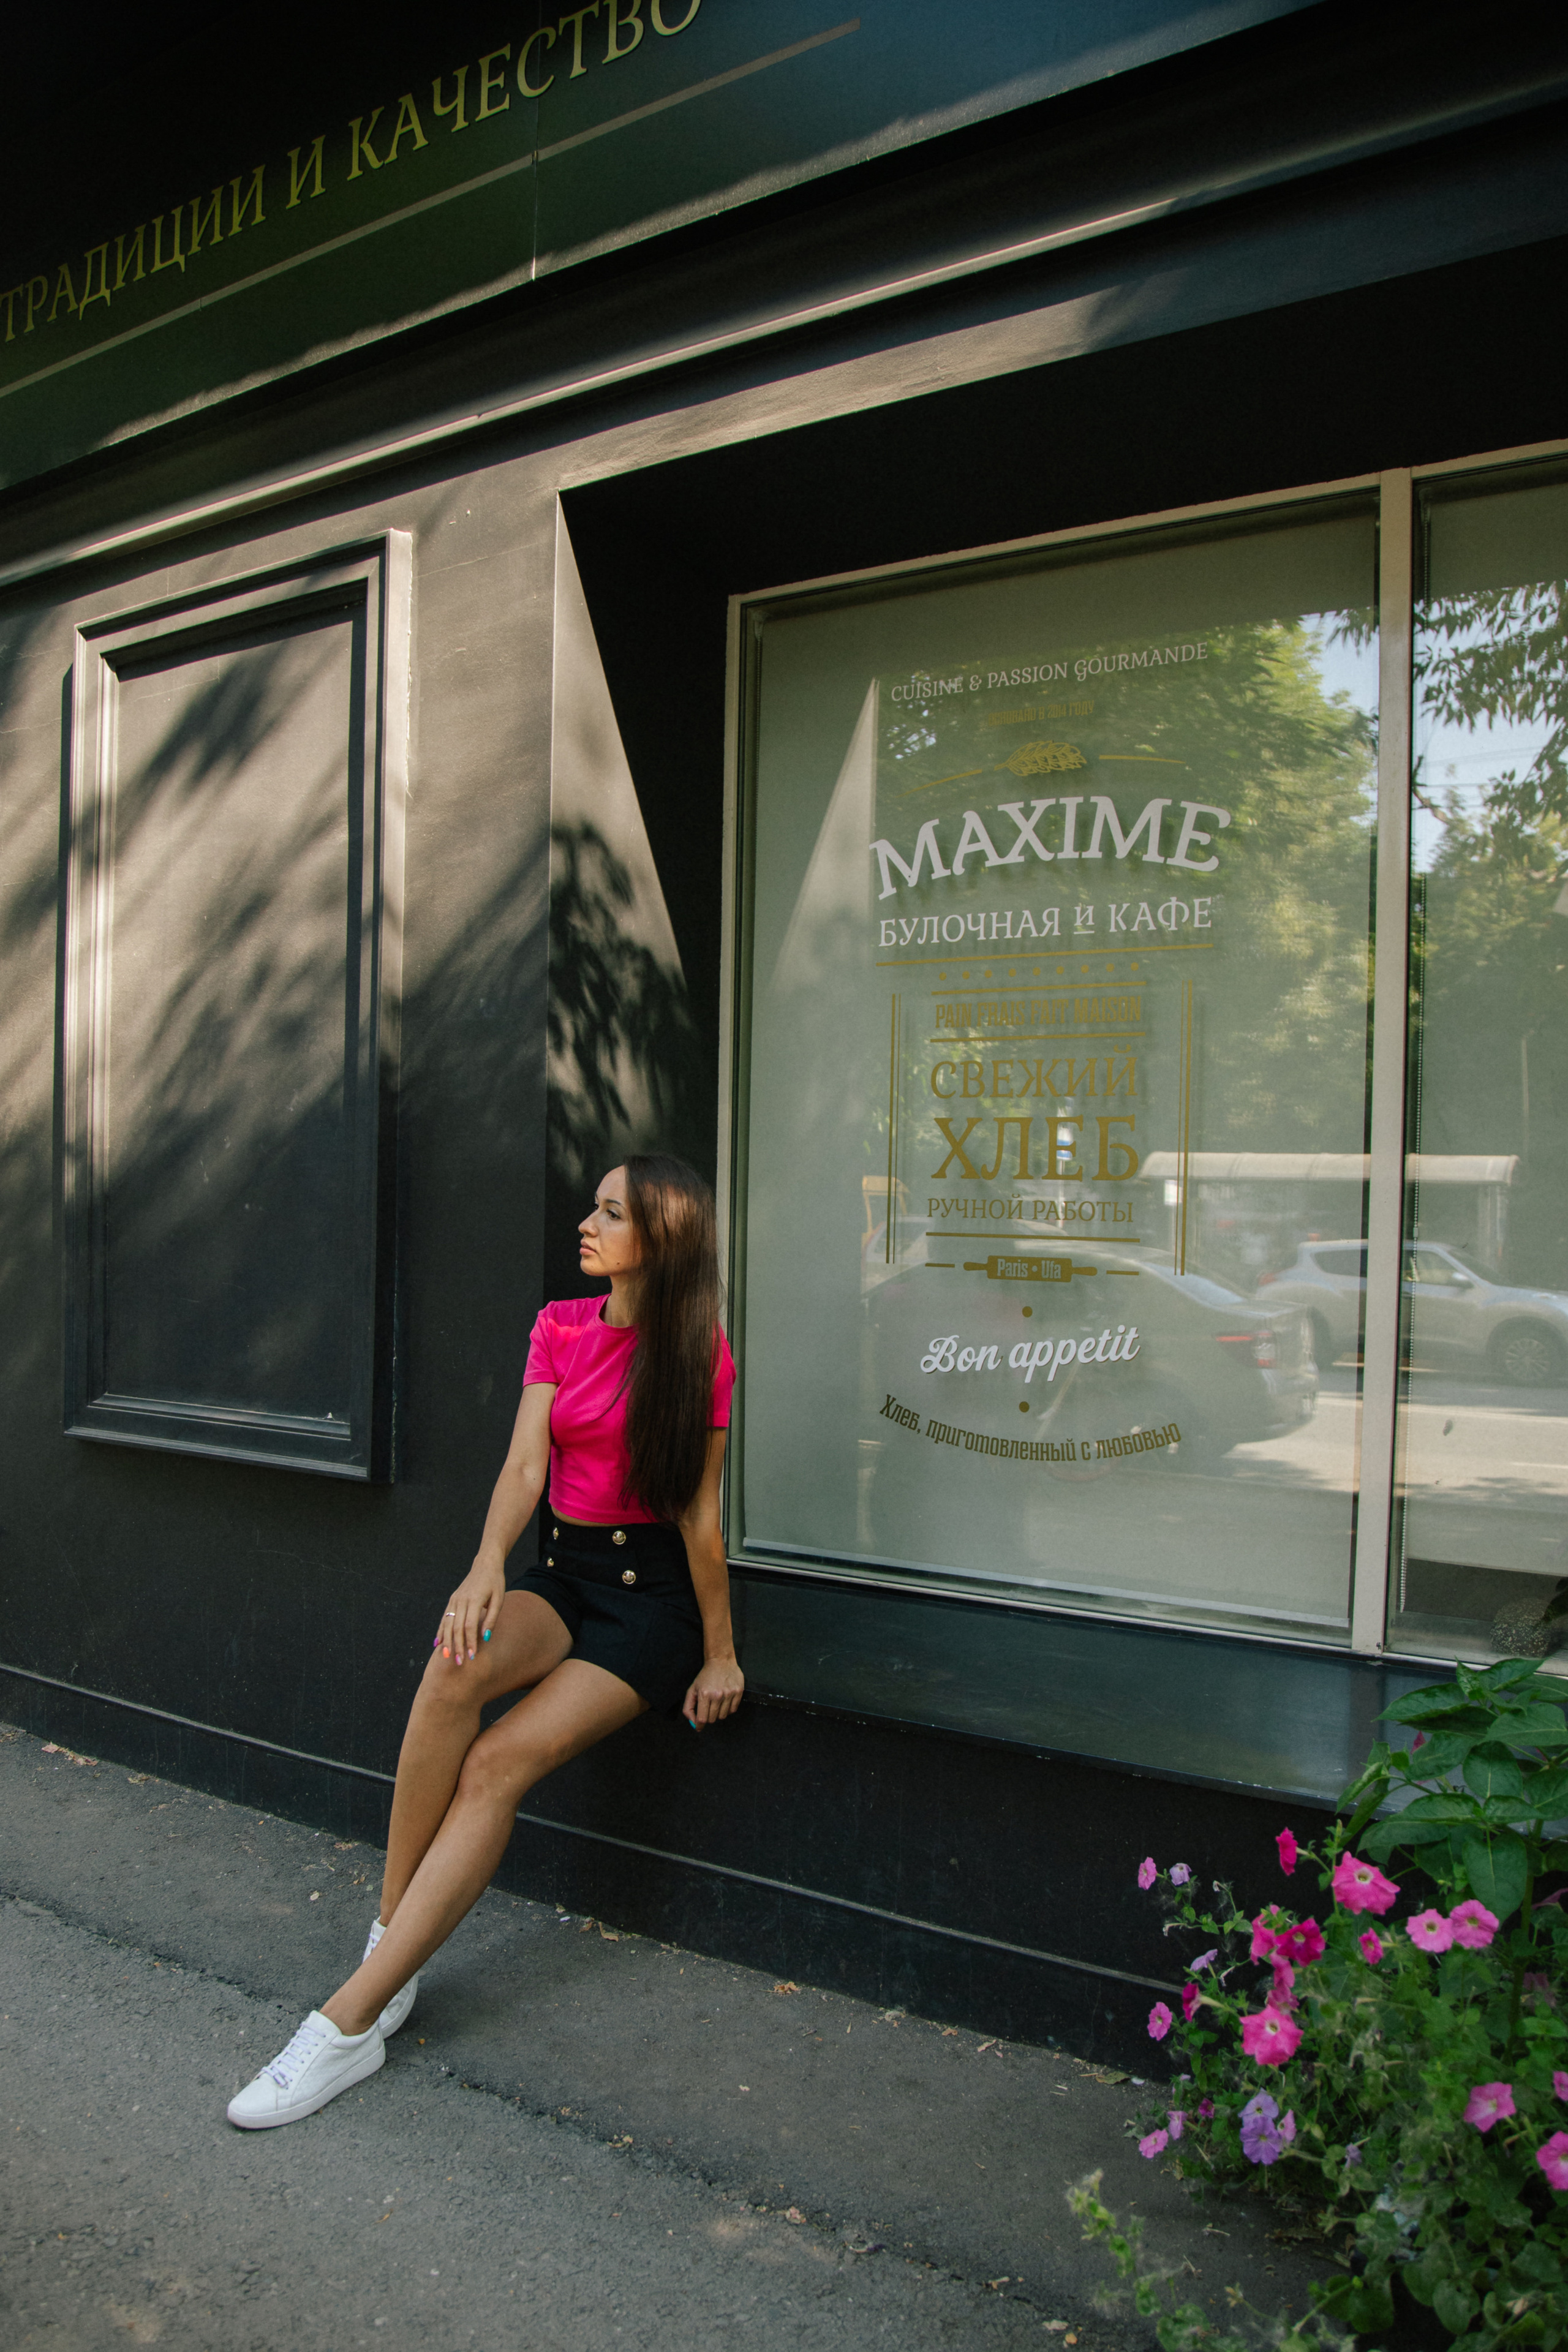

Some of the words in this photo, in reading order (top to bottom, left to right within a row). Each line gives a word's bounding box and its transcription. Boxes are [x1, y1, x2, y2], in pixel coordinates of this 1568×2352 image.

[0, 164, 266, 343] ТРАДИЦИИ
[285, 134, 326, 209] И
[891, 676, 963, 702] CUISINE
[969, 674, 982, 691] &
[987, 662, 1068, 689] PASSION
[1074, 641, 1208, 682] GOURMANDE
[869, 796, 1232, 900] MAXIME
[879, 907, 1061, 947] БУЛОЧНАЯ
[1109, 896, 1213, 932] КАФЕ
[935, 1003, 972, 1028] PAIN
[977, 1001, 1026, 1027] FRAIS
[1030, 998, 1069, 1025] FAIT
[1074, 996, 1142, 1023] MAISON
[930, 1044, 1138, 1098] СВЕЖИЙ
[931, 1114, 1139, 1182] ХЛЕБ
[927, 1193, 1024, 1219] РУЧНОЙ
[1032, 1200, 1134, 1223] РАБОТЫ
[997, 1258, 1028, 1278] Paris
[1041, 1260, 1061, 1279] Ufa
[920, 1335, 1003, 1374] Bon
[1009, 1324, 1141, 1383] appetit
[880, 1393, 922, 1434] Хлеб,
[925, 1419, 1077, 1461] приготовленный
[1081, 1441, 1091, 1461] с
[1096, 1422, 1182, 1460] любовью
